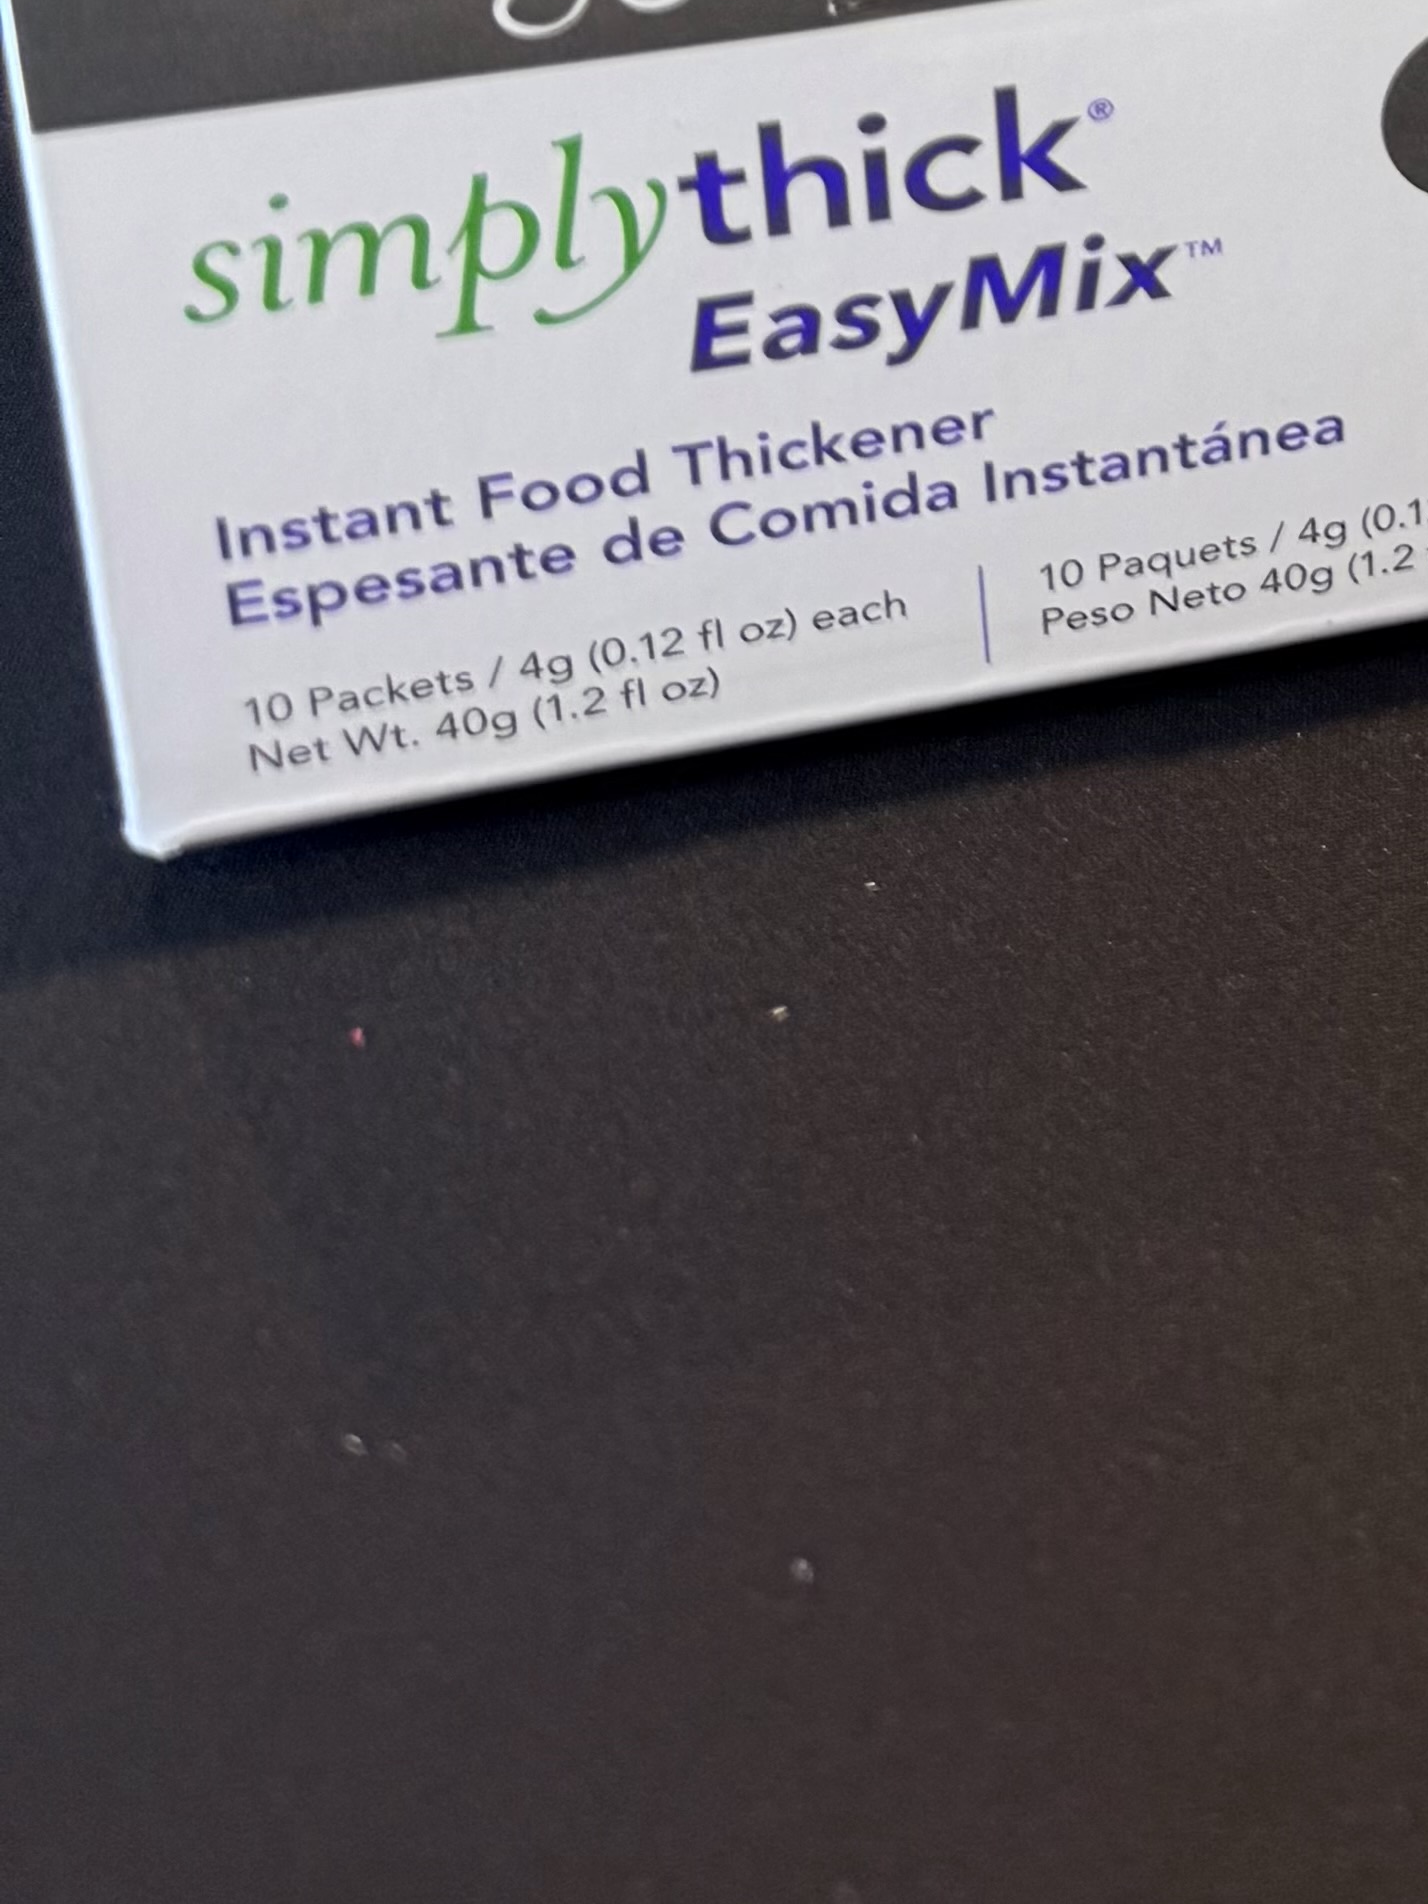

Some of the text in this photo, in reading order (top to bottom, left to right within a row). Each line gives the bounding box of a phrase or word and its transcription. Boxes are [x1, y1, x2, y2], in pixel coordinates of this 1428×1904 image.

[214, 406, 995, 563] Instant Food Thickener
[226, 410, 1346, 628] Espesante de Comida Instantánea
[1039, 558, 1085, 593] 10
[1099, 530, 1259, 587] Paquets
[1297, 514, 1349, 553] 4g
[1040, 600, 1136, 637] Peso
[1148, 578, 1248, 620] Neto
[1259, 561, 1335, 604] 40g
[1346, 549, 1414, 587] (1.2
[244, 692, 295, 730] 10
[308, 665, 476, 719] Packets
[517, 650, 574, 688] 4g
[587, 626, 687, 679] (0.12
[697, 617, 724, 652] fl
[739, 607, 798, 644] oz)
[811, 589, 909, 635] each
[247, 669, 722, 774] Net Wt. 40g (1.2 fl oz)
